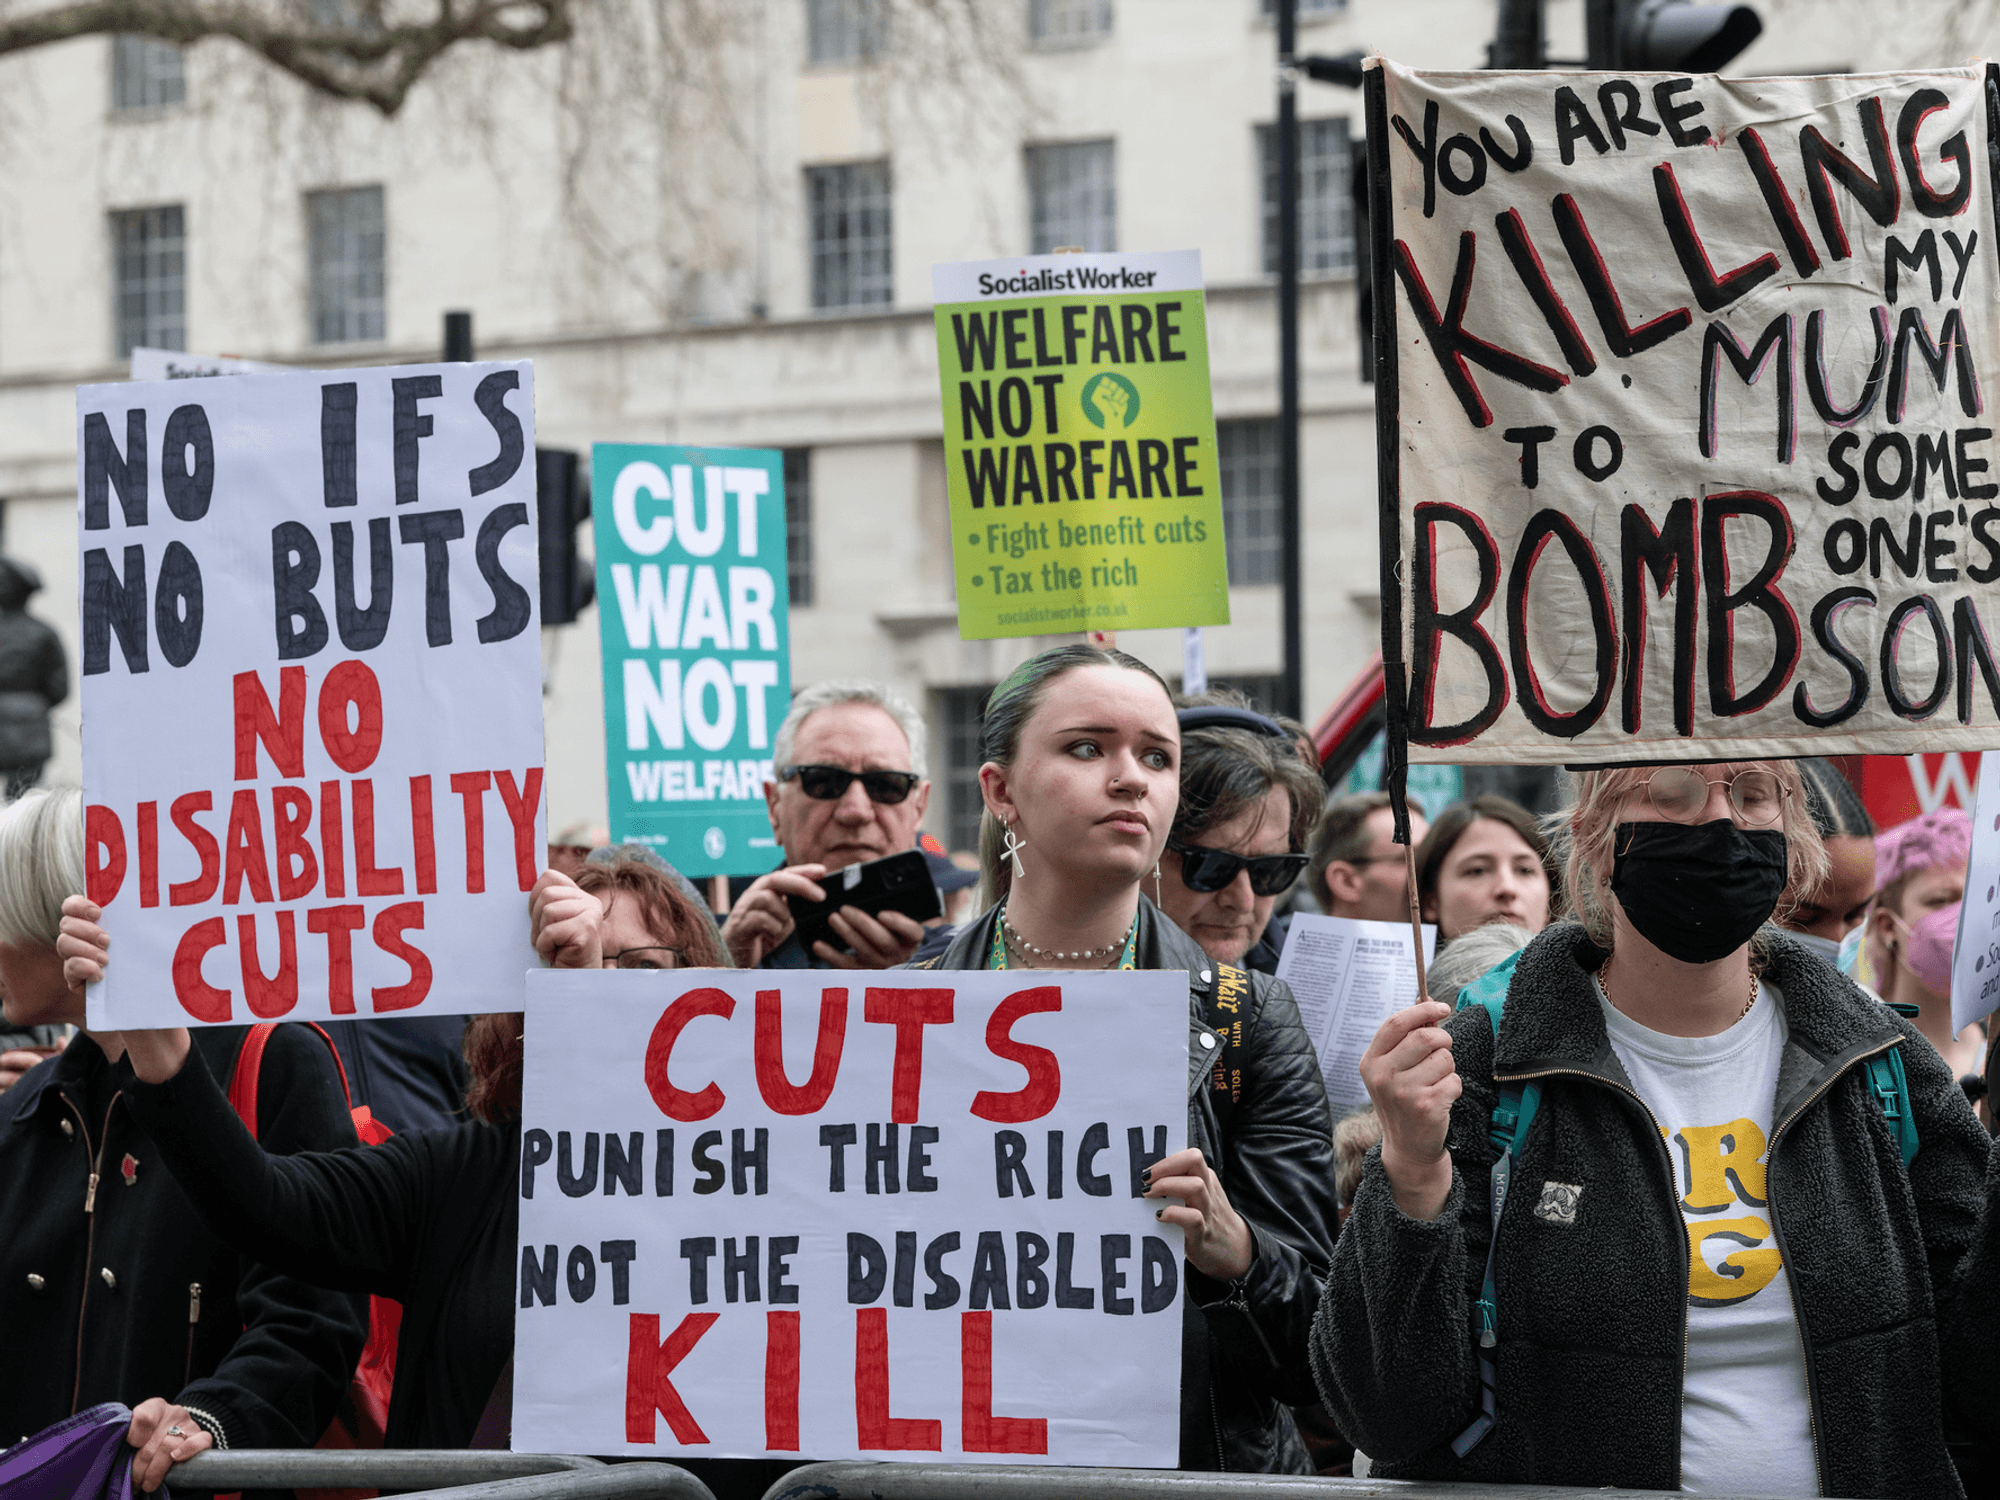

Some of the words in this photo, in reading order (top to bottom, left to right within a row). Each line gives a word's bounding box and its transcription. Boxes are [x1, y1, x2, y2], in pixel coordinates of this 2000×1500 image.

[1391, 99, 1534, 218] YOU
[1554, 77, 1711, 166] ARE
[1393, 88, 1972, 428] KILLING
[1885, 229, 1978, 304] MY
[951, 302, 1187, 373] WELFARE
[959, 374, 1064, 441] NOT
[1700, 305, 1985, 465] MUM
[84, 404, 214, 531] NO
[321, 369, 524, 508] IFS
[962, 436, 1204, 509] WARFARE
[1503, 425, 1624, 489] TO
[1816, 428, 1998, 506] SOME
[612, 460, 770, 557] CUT
[986, 522, 1050, 560] Fight
[1058, 516, 1146, 548] benefit
[1154, 515, 1207, 544] cuts
[1823, 503, 2000, 584] ONE'S
[83, 540, 204, 675] NO
[272, 503, 531, 660] BUTS
[610, 563, 778, 650] WAR
[988, 565, 1034, 596] Tax
[1041, 561, 1082, 591] the
[1091, 557, 1139, 588] rich
[1408, 489, 1802, 749] BOMB
[233, 659, 383, 781] NO
[622, 657, 778, 751] NOT
[85, 767, 544, 909] DISABILITY
[172, 901, 433, 1023] CUTS
[644, 985, 1062, 1123] CUTS
[1232, 1020, 1242, 1048] WITH
[521, 1126, 769, 1200] PUNISH
[819, 1123, 940, 1194] THE
[994, 1122, 1168, 1200] RICH
[520, 1239, 637, 1309] NOT
[680, 1235, 801, 1305] THE
[846, 1230, 1178, 1316] DISABLED
[626, 1307, 1049, 1455] KILL
